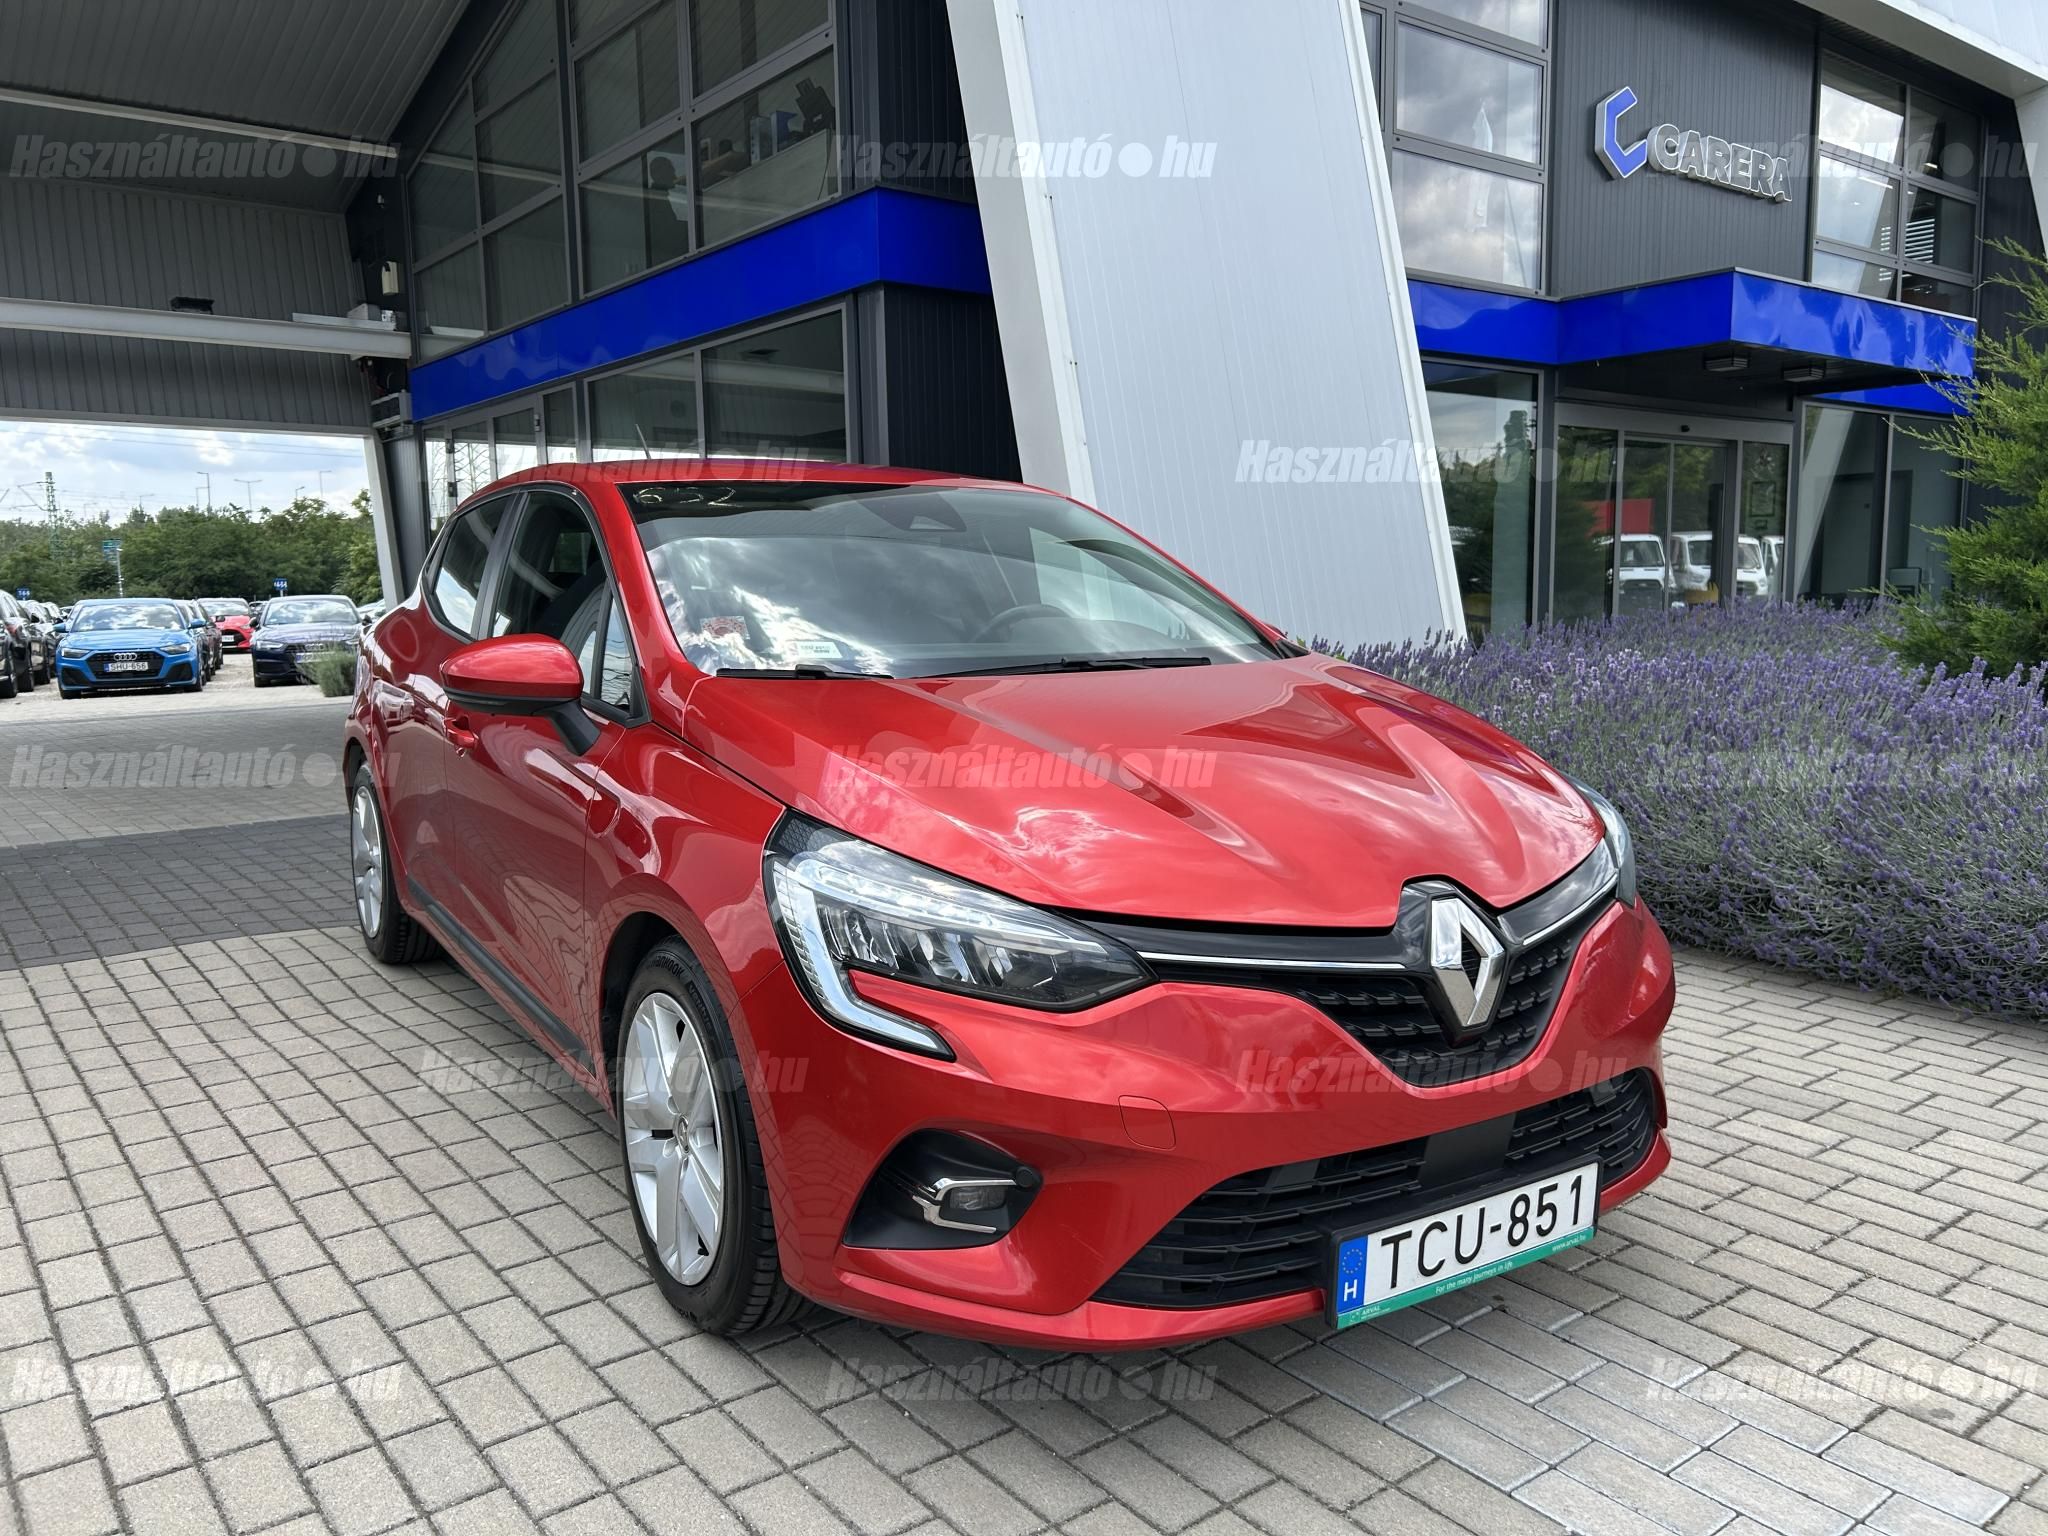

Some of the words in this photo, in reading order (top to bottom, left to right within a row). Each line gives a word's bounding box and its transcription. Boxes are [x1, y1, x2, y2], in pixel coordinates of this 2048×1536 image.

[1648, 123, 1793, 202] CARERA
[1381, 1175, 1583, 1289] TCU-851
[1343, 1278, 1358, 1302] H
